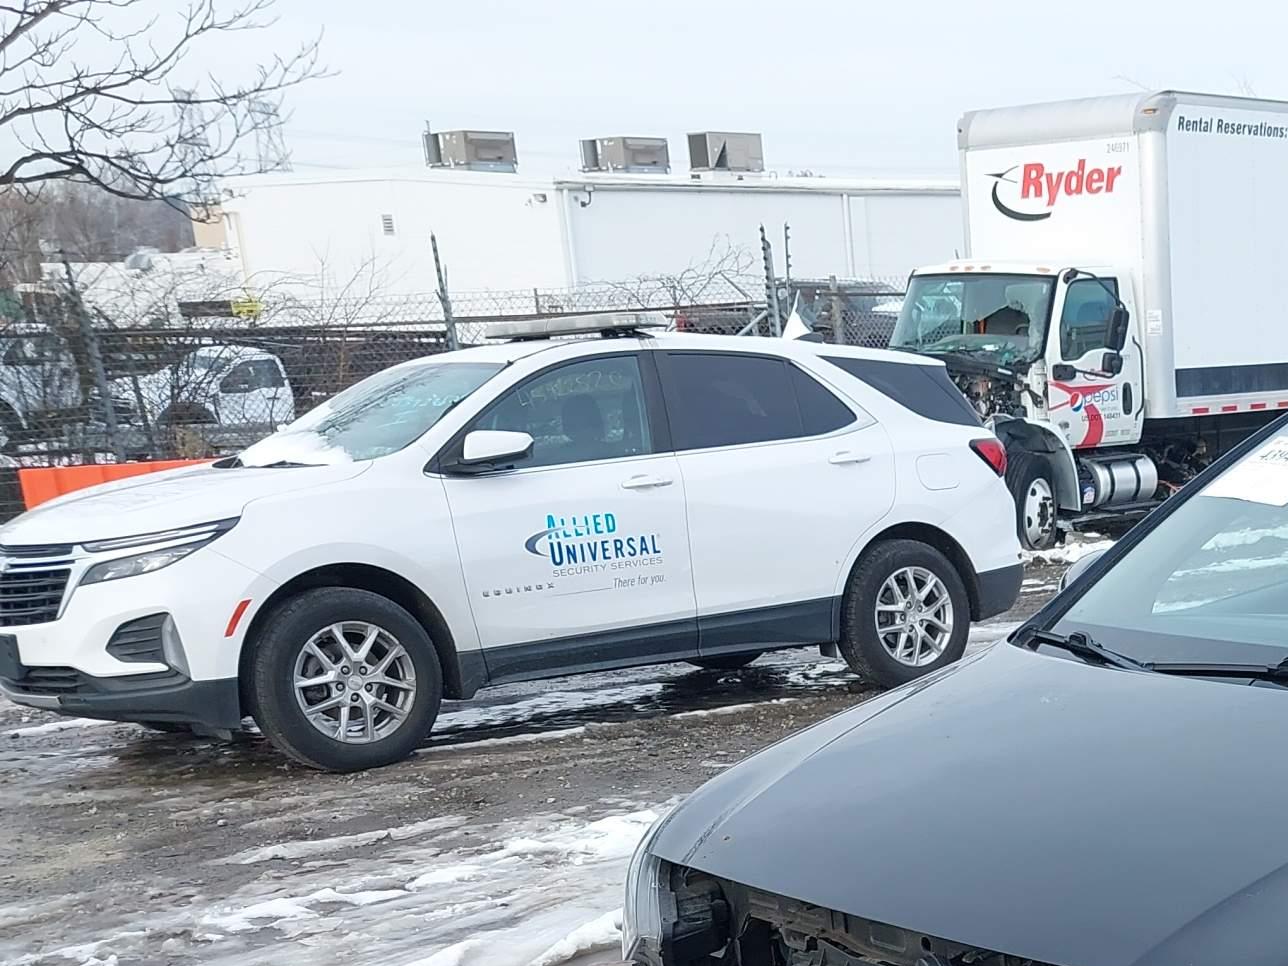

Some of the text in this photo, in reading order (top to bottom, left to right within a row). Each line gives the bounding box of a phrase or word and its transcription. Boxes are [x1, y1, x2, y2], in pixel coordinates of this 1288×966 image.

[1177, 115, 1213, 133] Rental
[1217, 118, 1288, 139] Reservations:
[1021, 158, 1122, 207] Ryder
[1083, 387, 1119, 405] pepsi
[547, 512, 616, 540] ALLIED
[549, 534, 662, 567] UNIVERSAL
[552, 556, 663, 577] SECURITY SERVICES
[613, 573, 667, 589] There for you.
